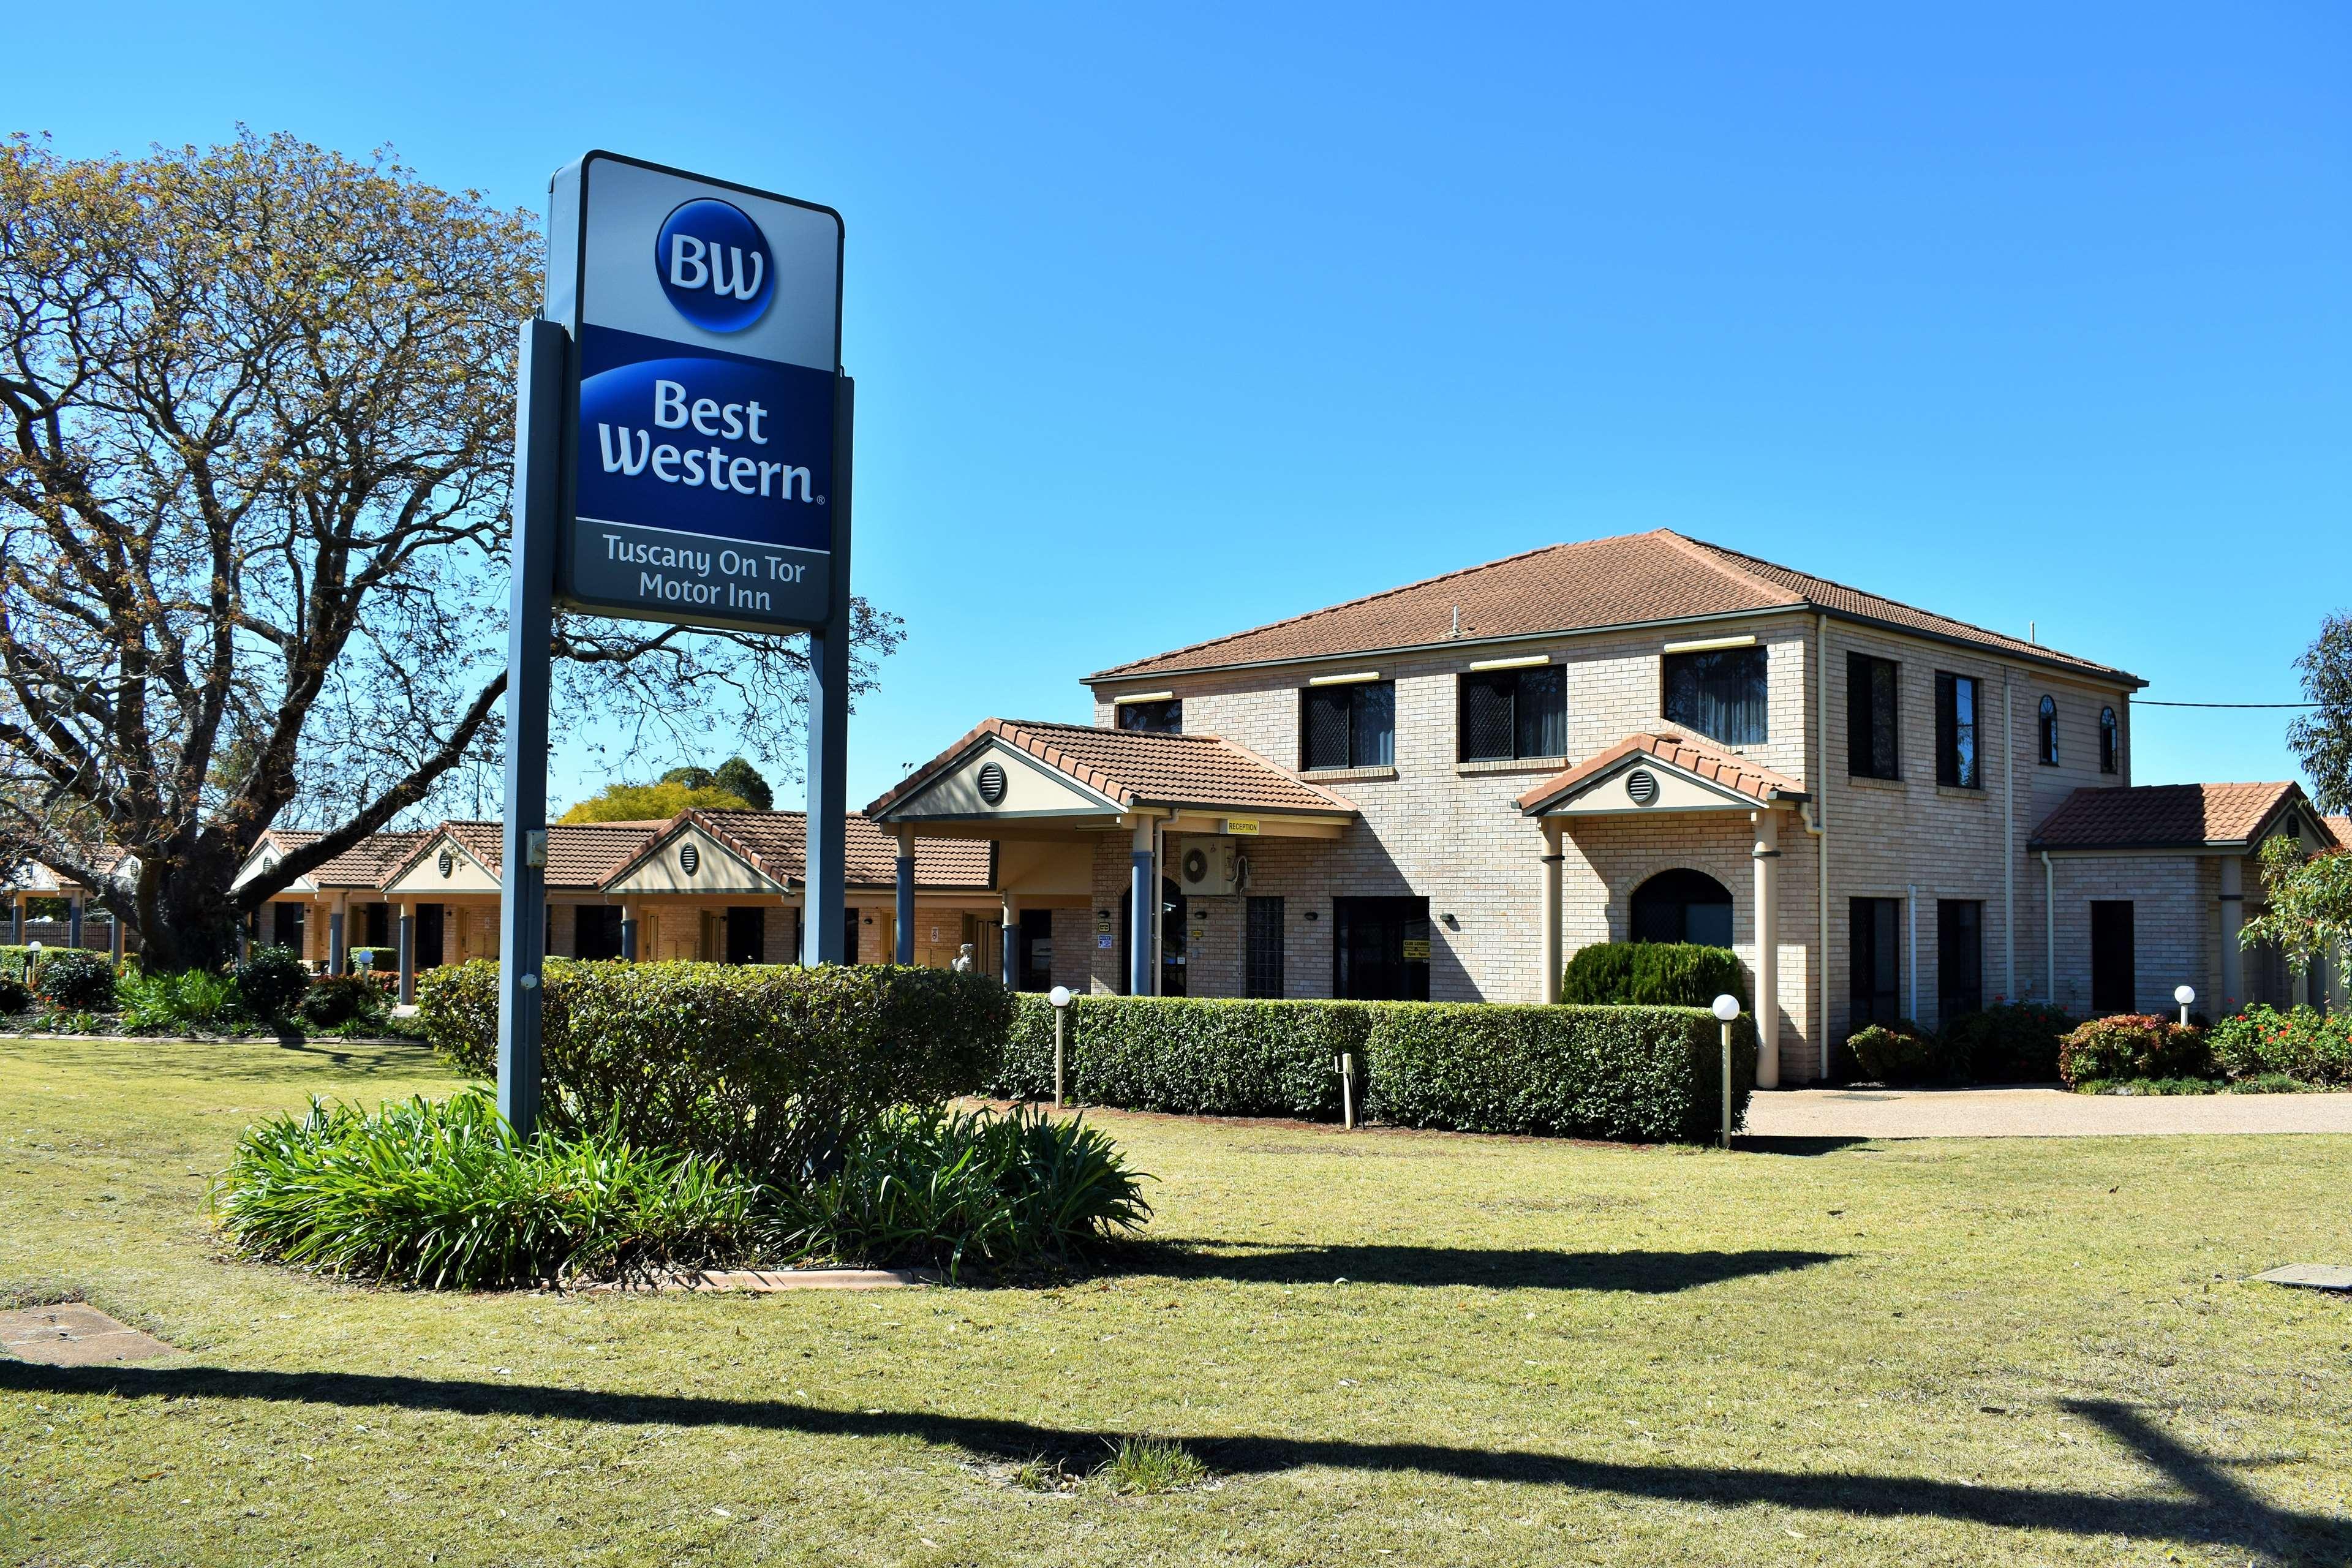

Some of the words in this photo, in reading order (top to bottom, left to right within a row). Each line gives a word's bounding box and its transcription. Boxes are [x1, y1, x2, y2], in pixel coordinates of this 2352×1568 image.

[671, 234, 764, 301] BW
[654, 379, 768, 445] Best
[602, 533, 710, 578] Tuscany
[719, 550, 758, 578] On
[764, 556, 806, 583] Tor
[639, 571, 721, 605] Motor
[729, 582, 771, 611] Inn
[1229, 823, 1257, 831] RECEPTION
